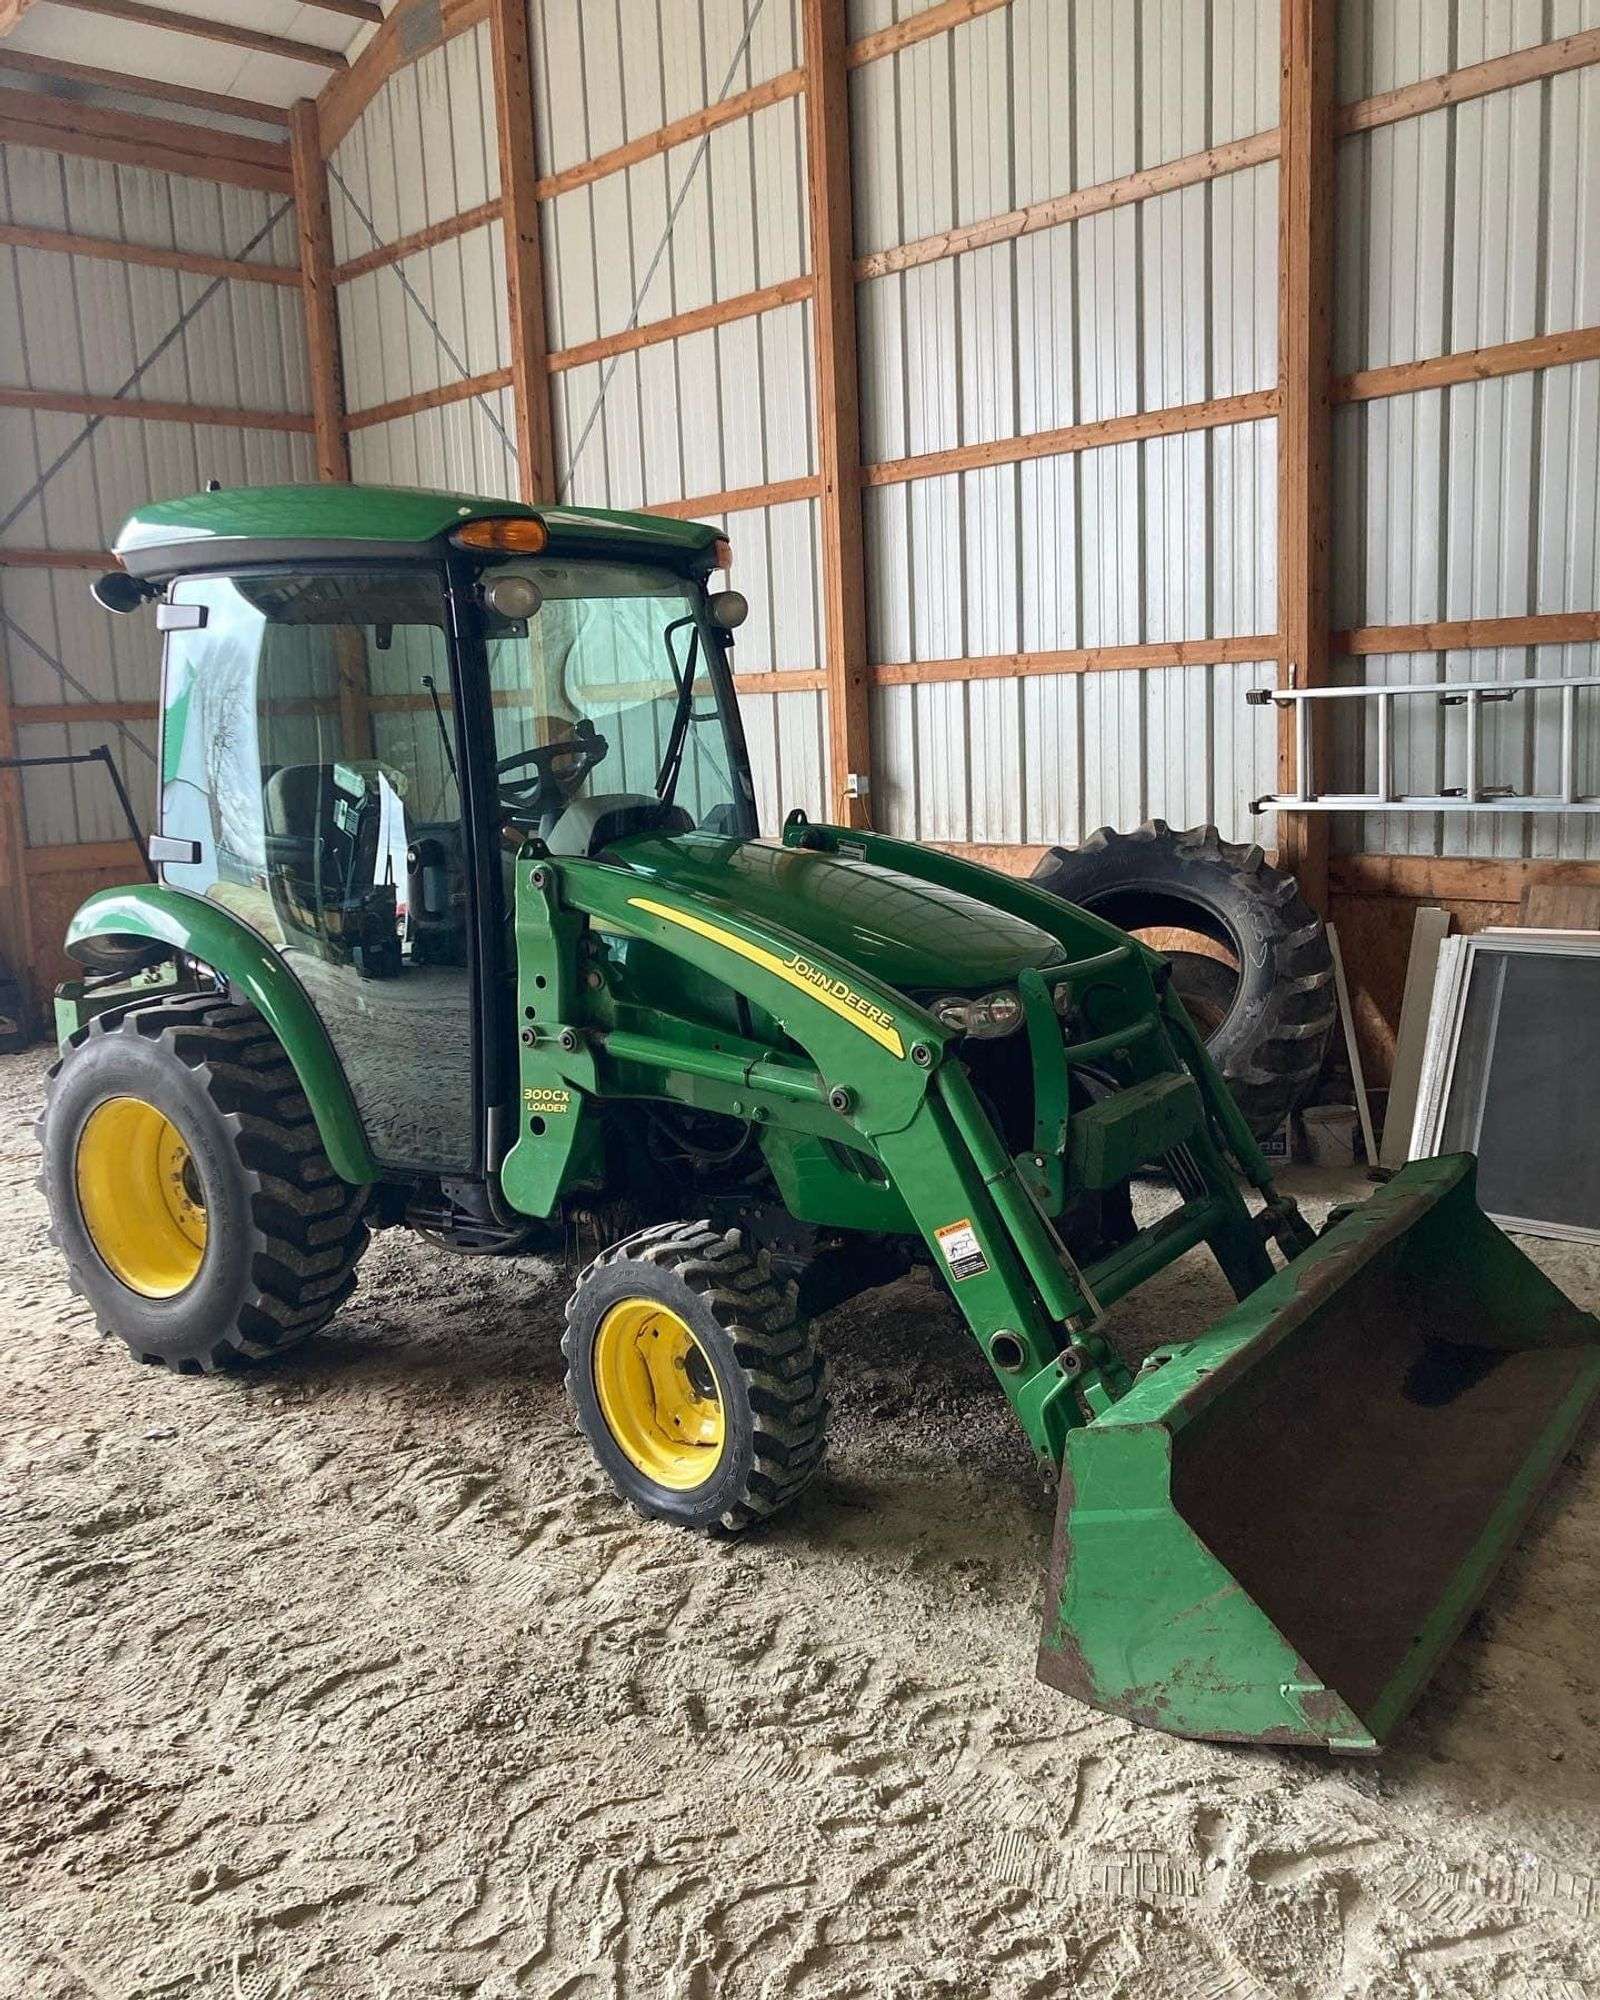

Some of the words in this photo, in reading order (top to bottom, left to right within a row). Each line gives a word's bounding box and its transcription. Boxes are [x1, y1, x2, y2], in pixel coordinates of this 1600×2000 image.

[783, 954, 832, 991] JOHN
[831, 981, 895, 1029] DEERE
[523, 1088, 570, 1102] 300CX
[527, 1102, 567, 1113] LOADER
